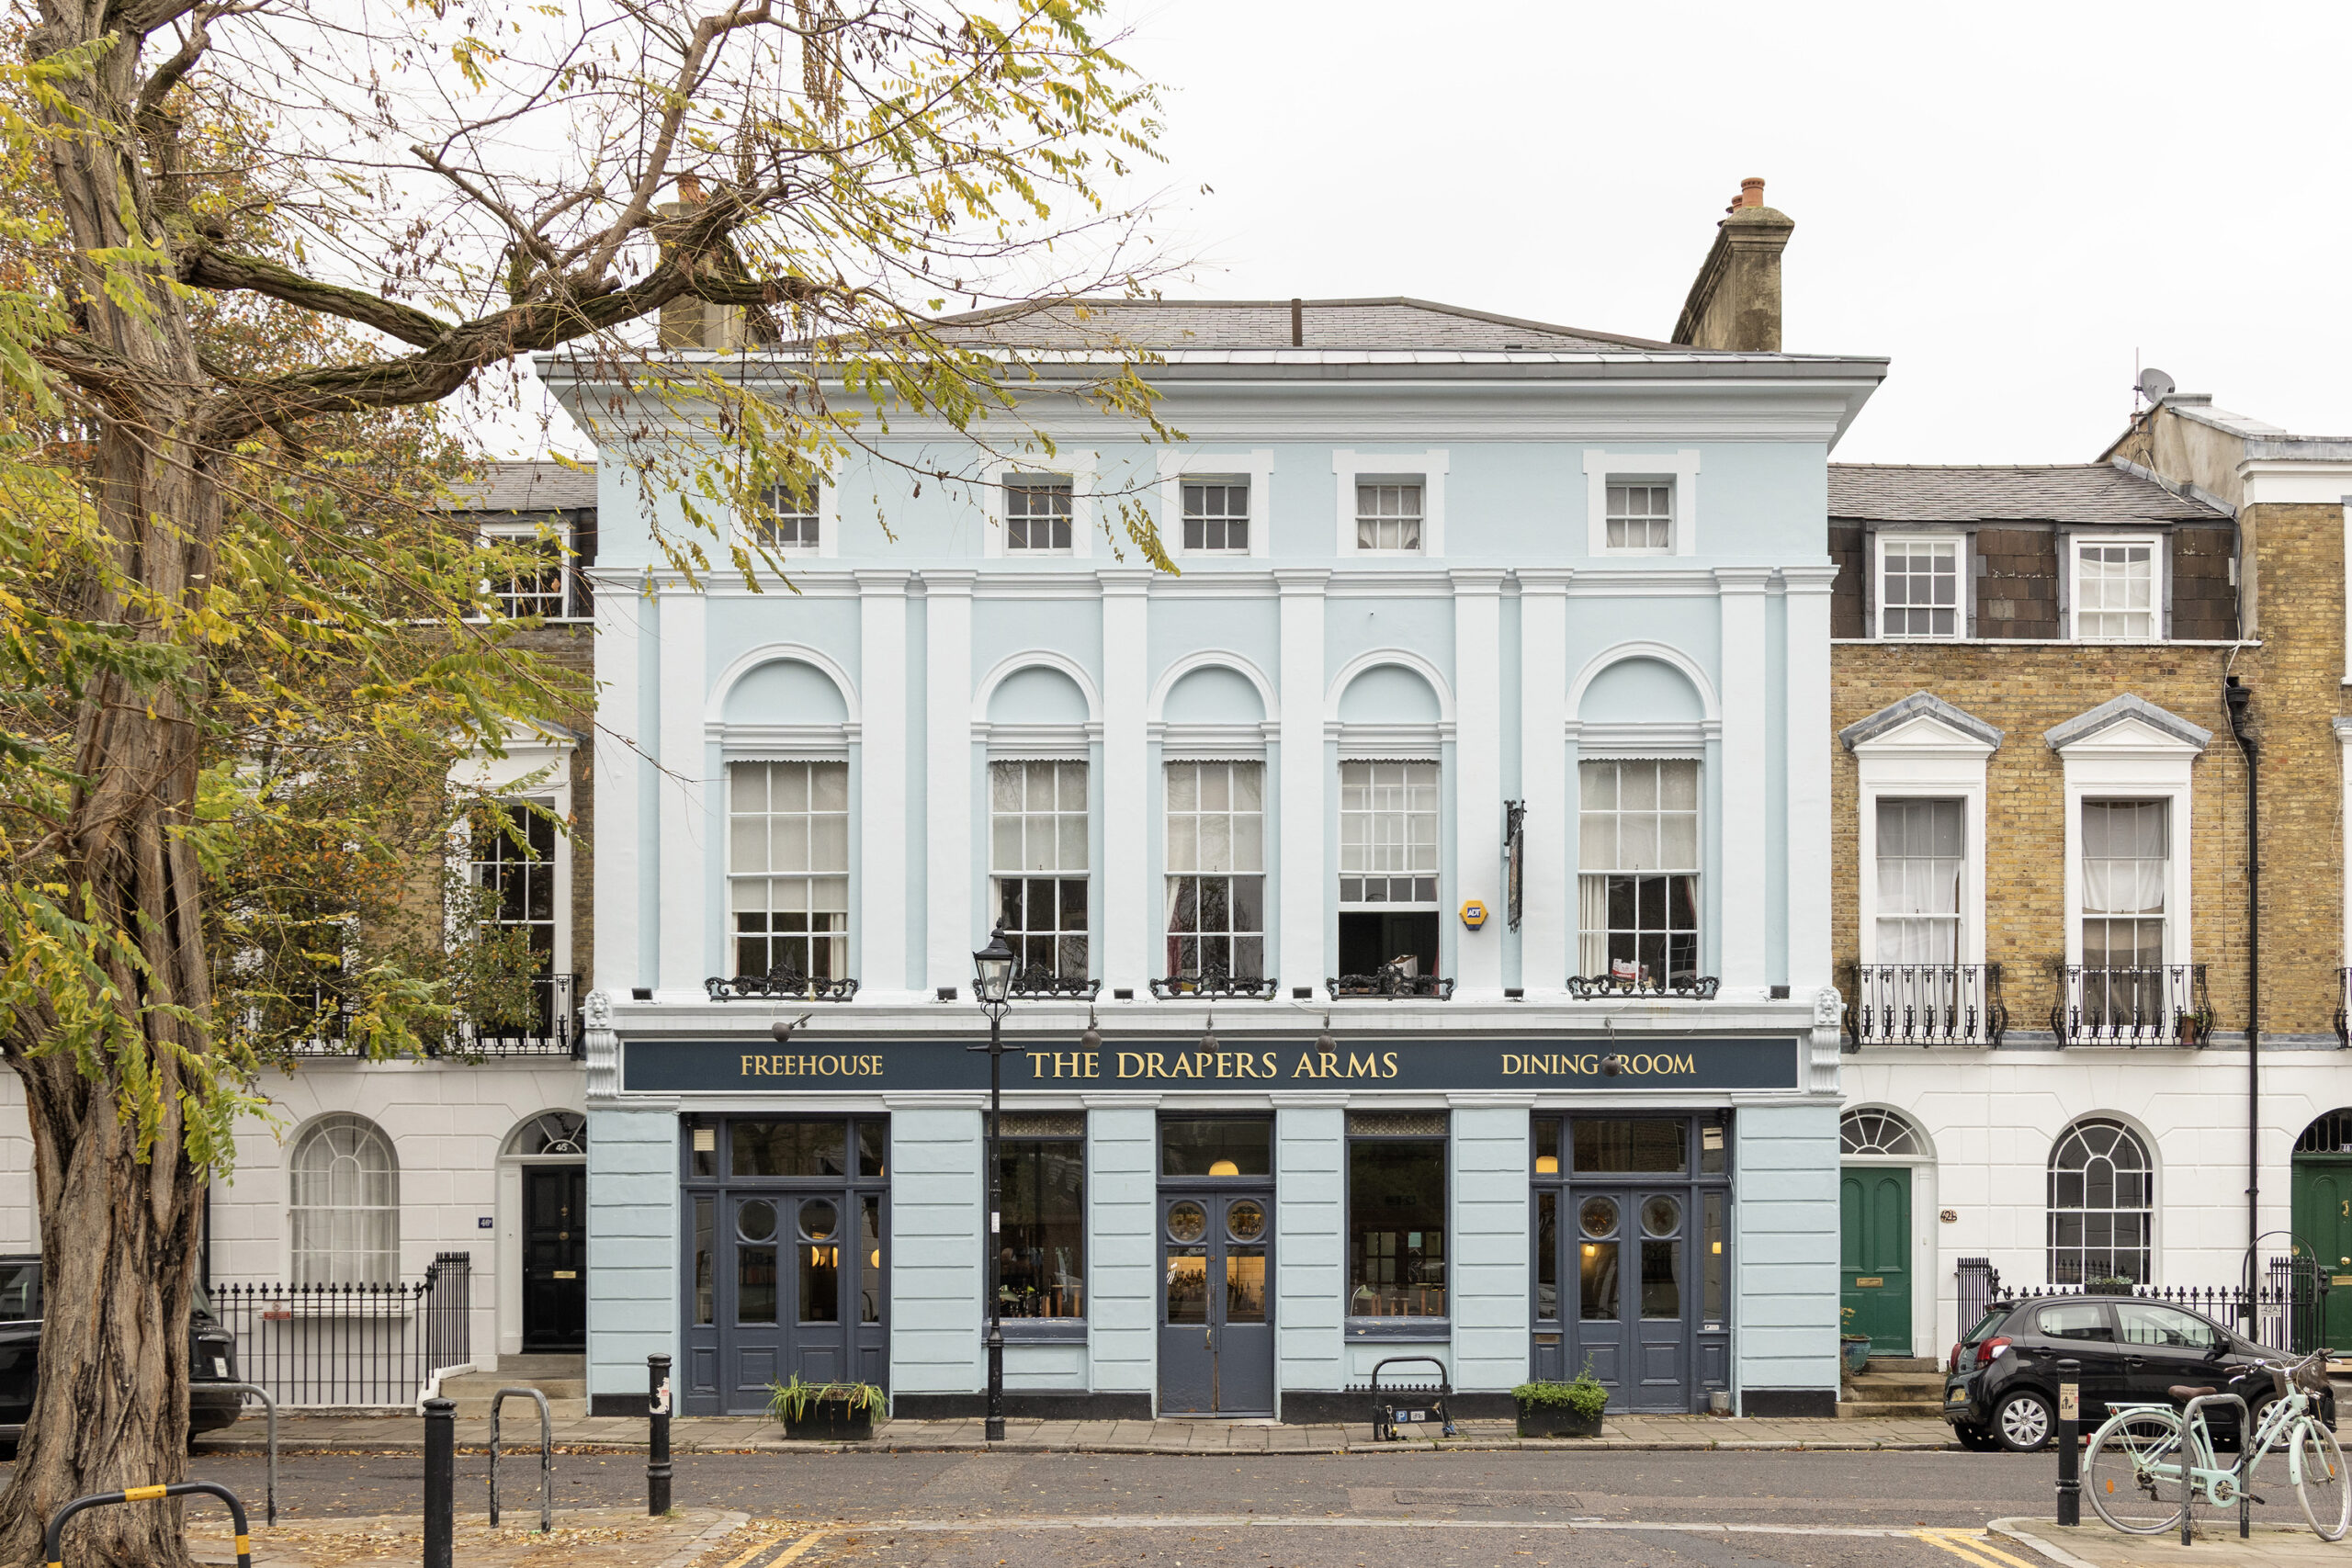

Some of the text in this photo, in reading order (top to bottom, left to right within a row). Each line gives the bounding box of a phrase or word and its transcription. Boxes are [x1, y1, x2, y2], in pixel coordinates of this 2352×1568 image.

[1467, 908, 1481, 917] ADT
[741, 1055, 883, 1076] FREEHOUSE
[1026, 1052, 1398, 1078] THE DRAPERS ARMS
[1501, 1054, 1696, 1075] DINING ROOM
[556, 1143, 568, 1151] 46
[1398, 1412, 1405, 1420] P
